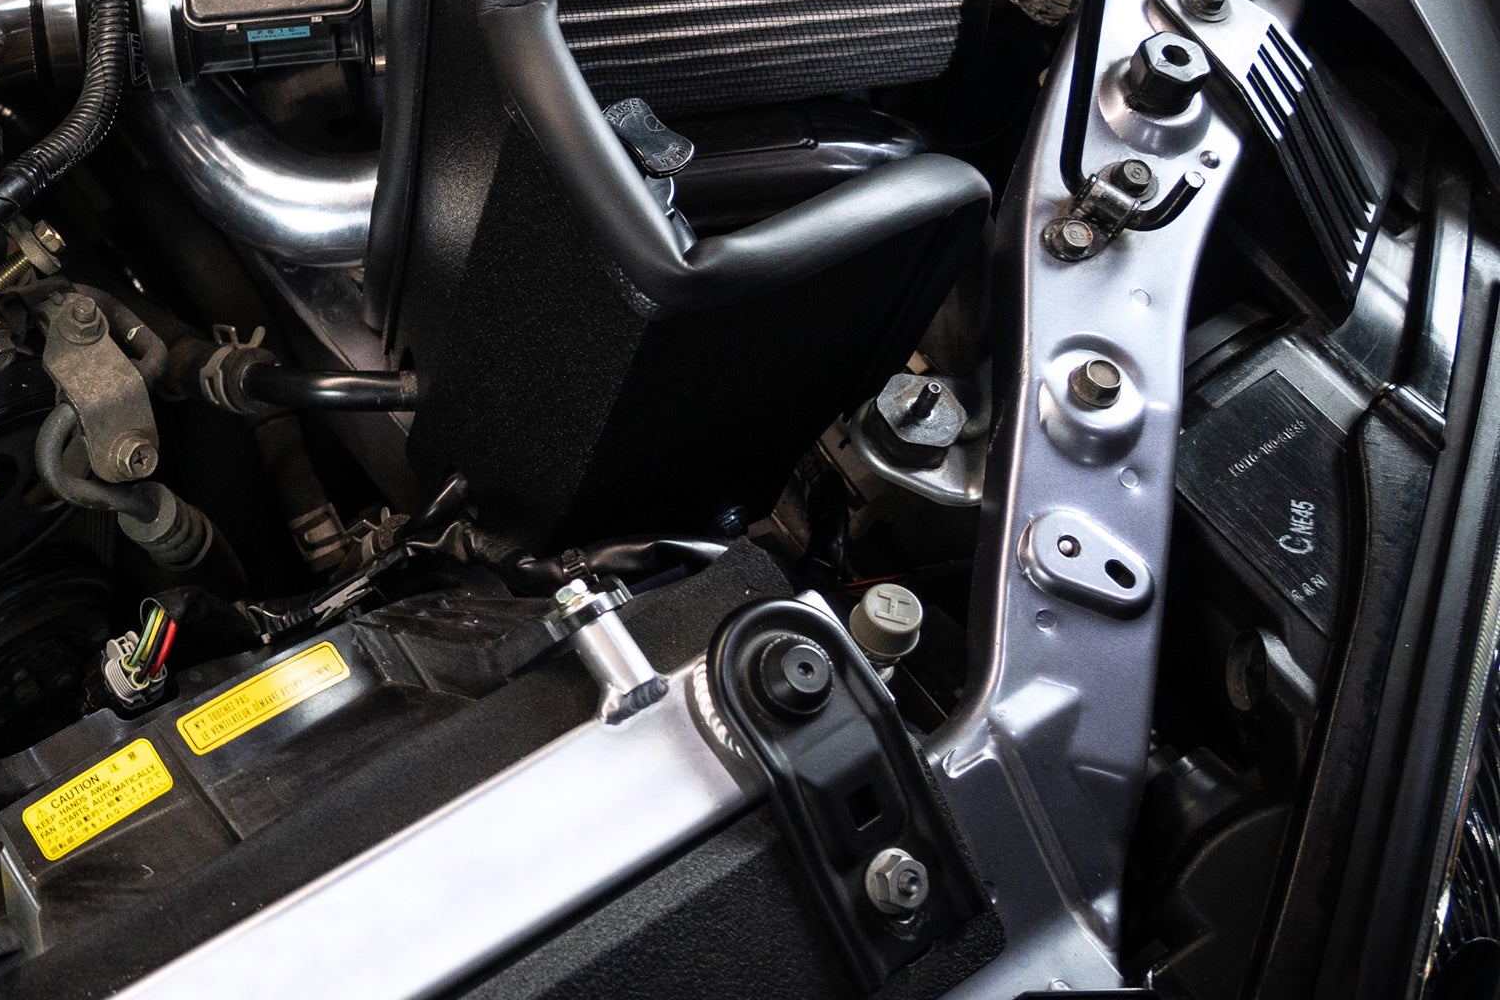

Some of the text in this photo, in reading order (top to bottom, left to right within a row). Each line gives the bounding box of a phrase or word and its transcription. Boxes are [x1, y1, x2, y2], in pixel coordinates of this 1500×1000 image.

[1289, 499, 1316, 536] NE45
[201, 730, 211, 742] LE
[212, 708, 252, 736] VENTILATEUR
[208, 702, 236, 723] TOUCHEZ
[50, 774, 100, 810] CAUTION
[35, 814, 57, 832] KEEP
[59, 795, 88, 817] HANDS
[40, 827, 57, 840] FAN
[58, 806, 90, 828] STARTS
